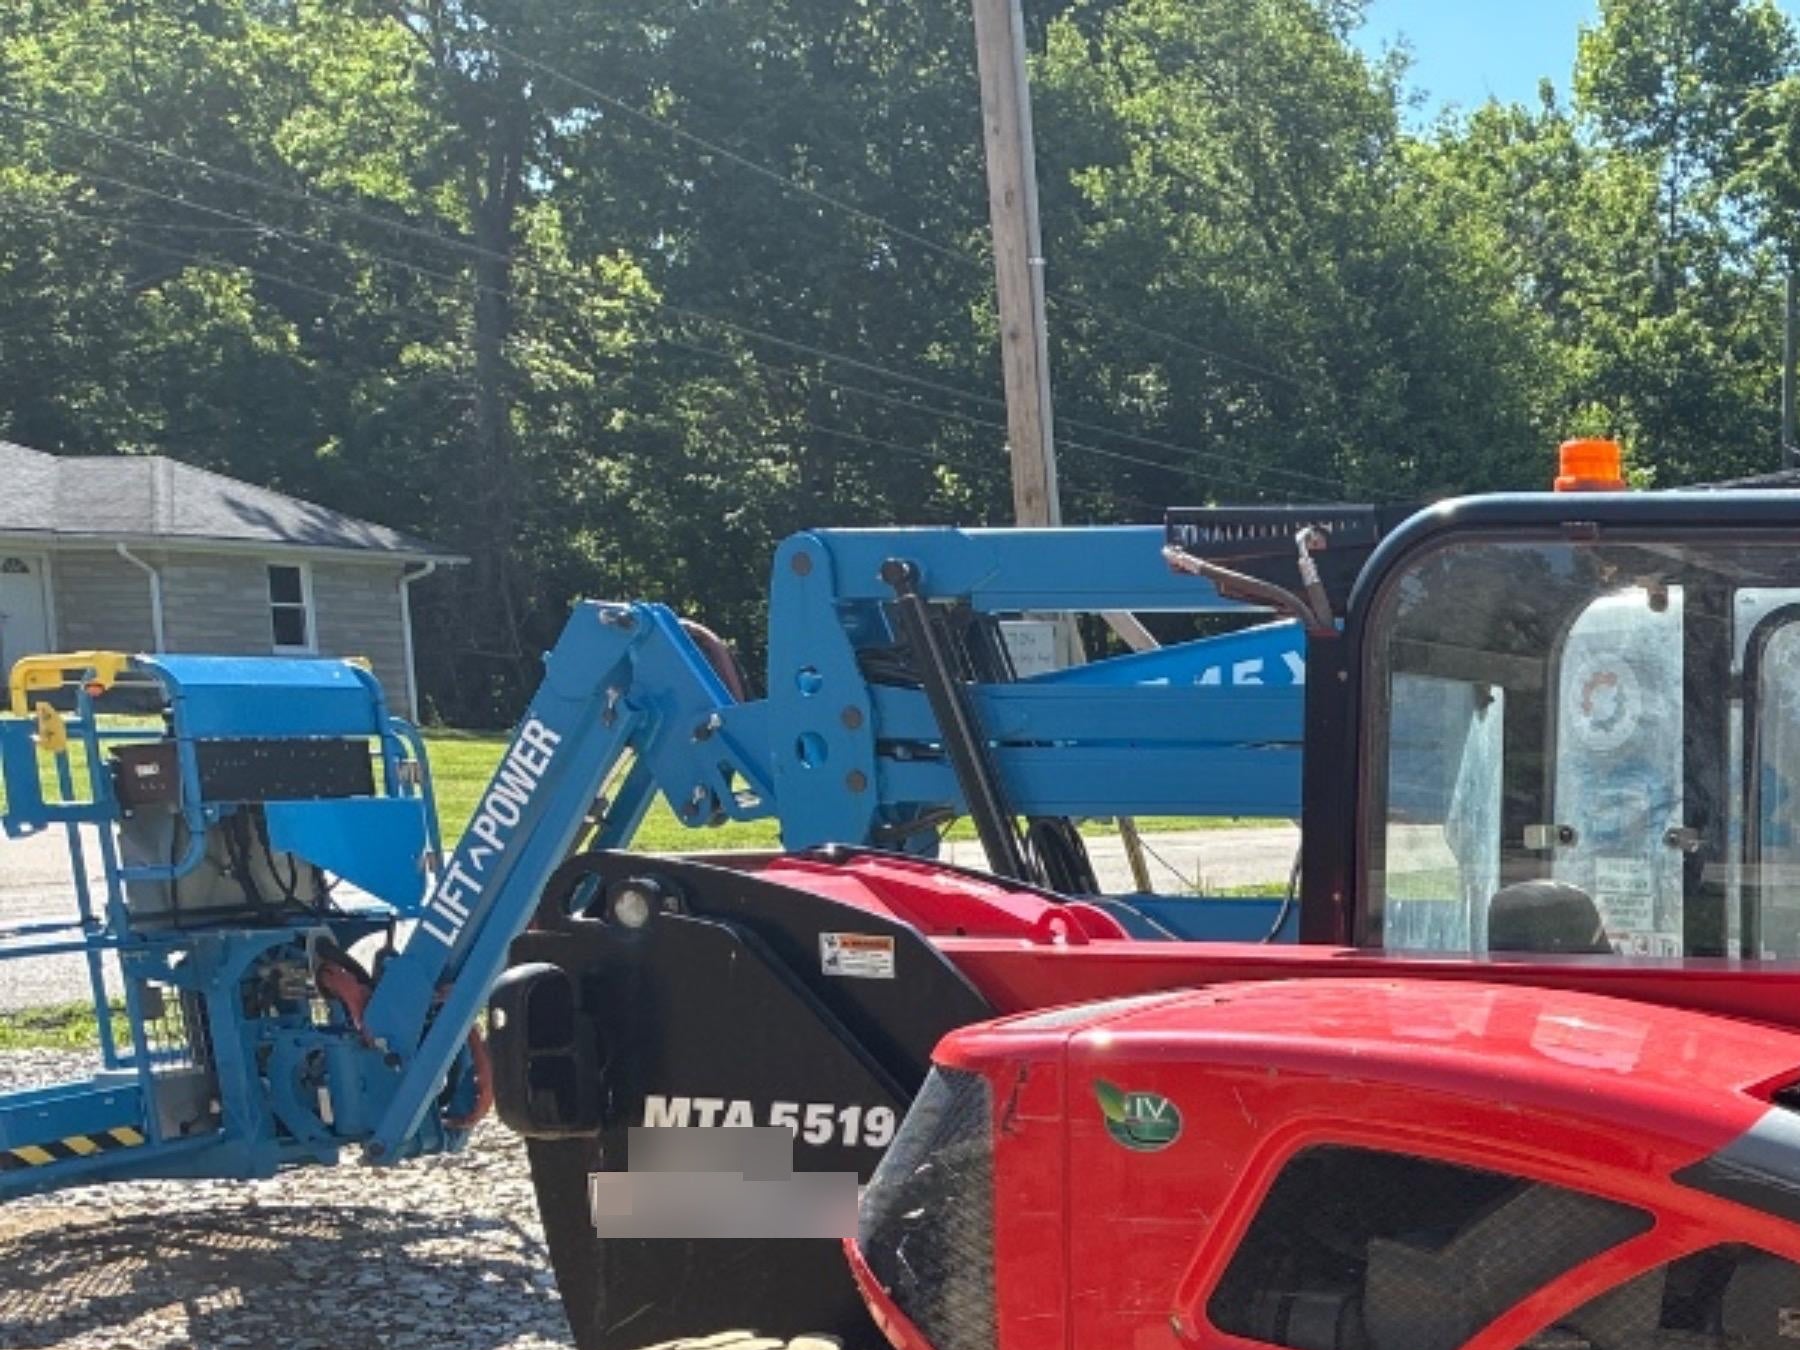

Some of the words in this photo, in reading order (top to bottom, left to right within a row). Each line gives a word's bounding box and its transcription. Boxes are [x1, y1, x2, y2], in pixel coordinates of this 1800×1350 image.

[421, 860, 484, 948] LIFT
[471, 718, 562, 851] POWER
[643, 1094, 755, 1128] MTA
[769, 1101, 897, 1148] 5519
